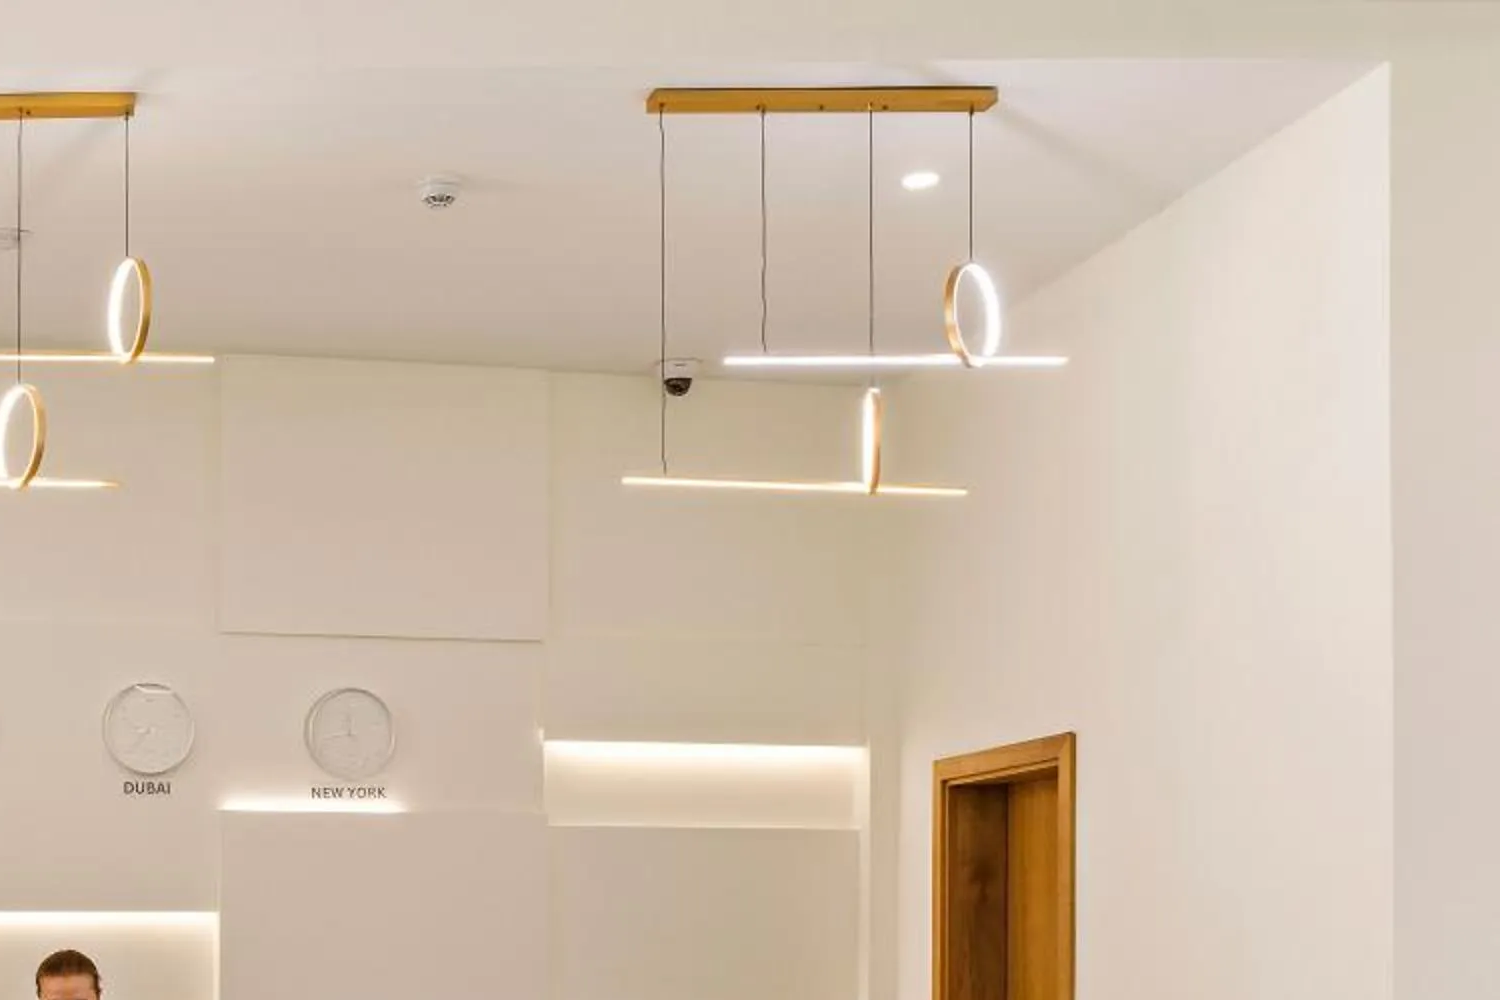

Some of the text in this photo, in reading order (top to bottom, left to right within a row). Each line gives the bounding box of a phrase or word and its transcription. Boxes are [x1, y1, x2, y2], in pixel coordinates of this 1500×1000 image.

[123, 781, 171, 795] DUBAI
[311, 787, 387, 799] NEW YORK
